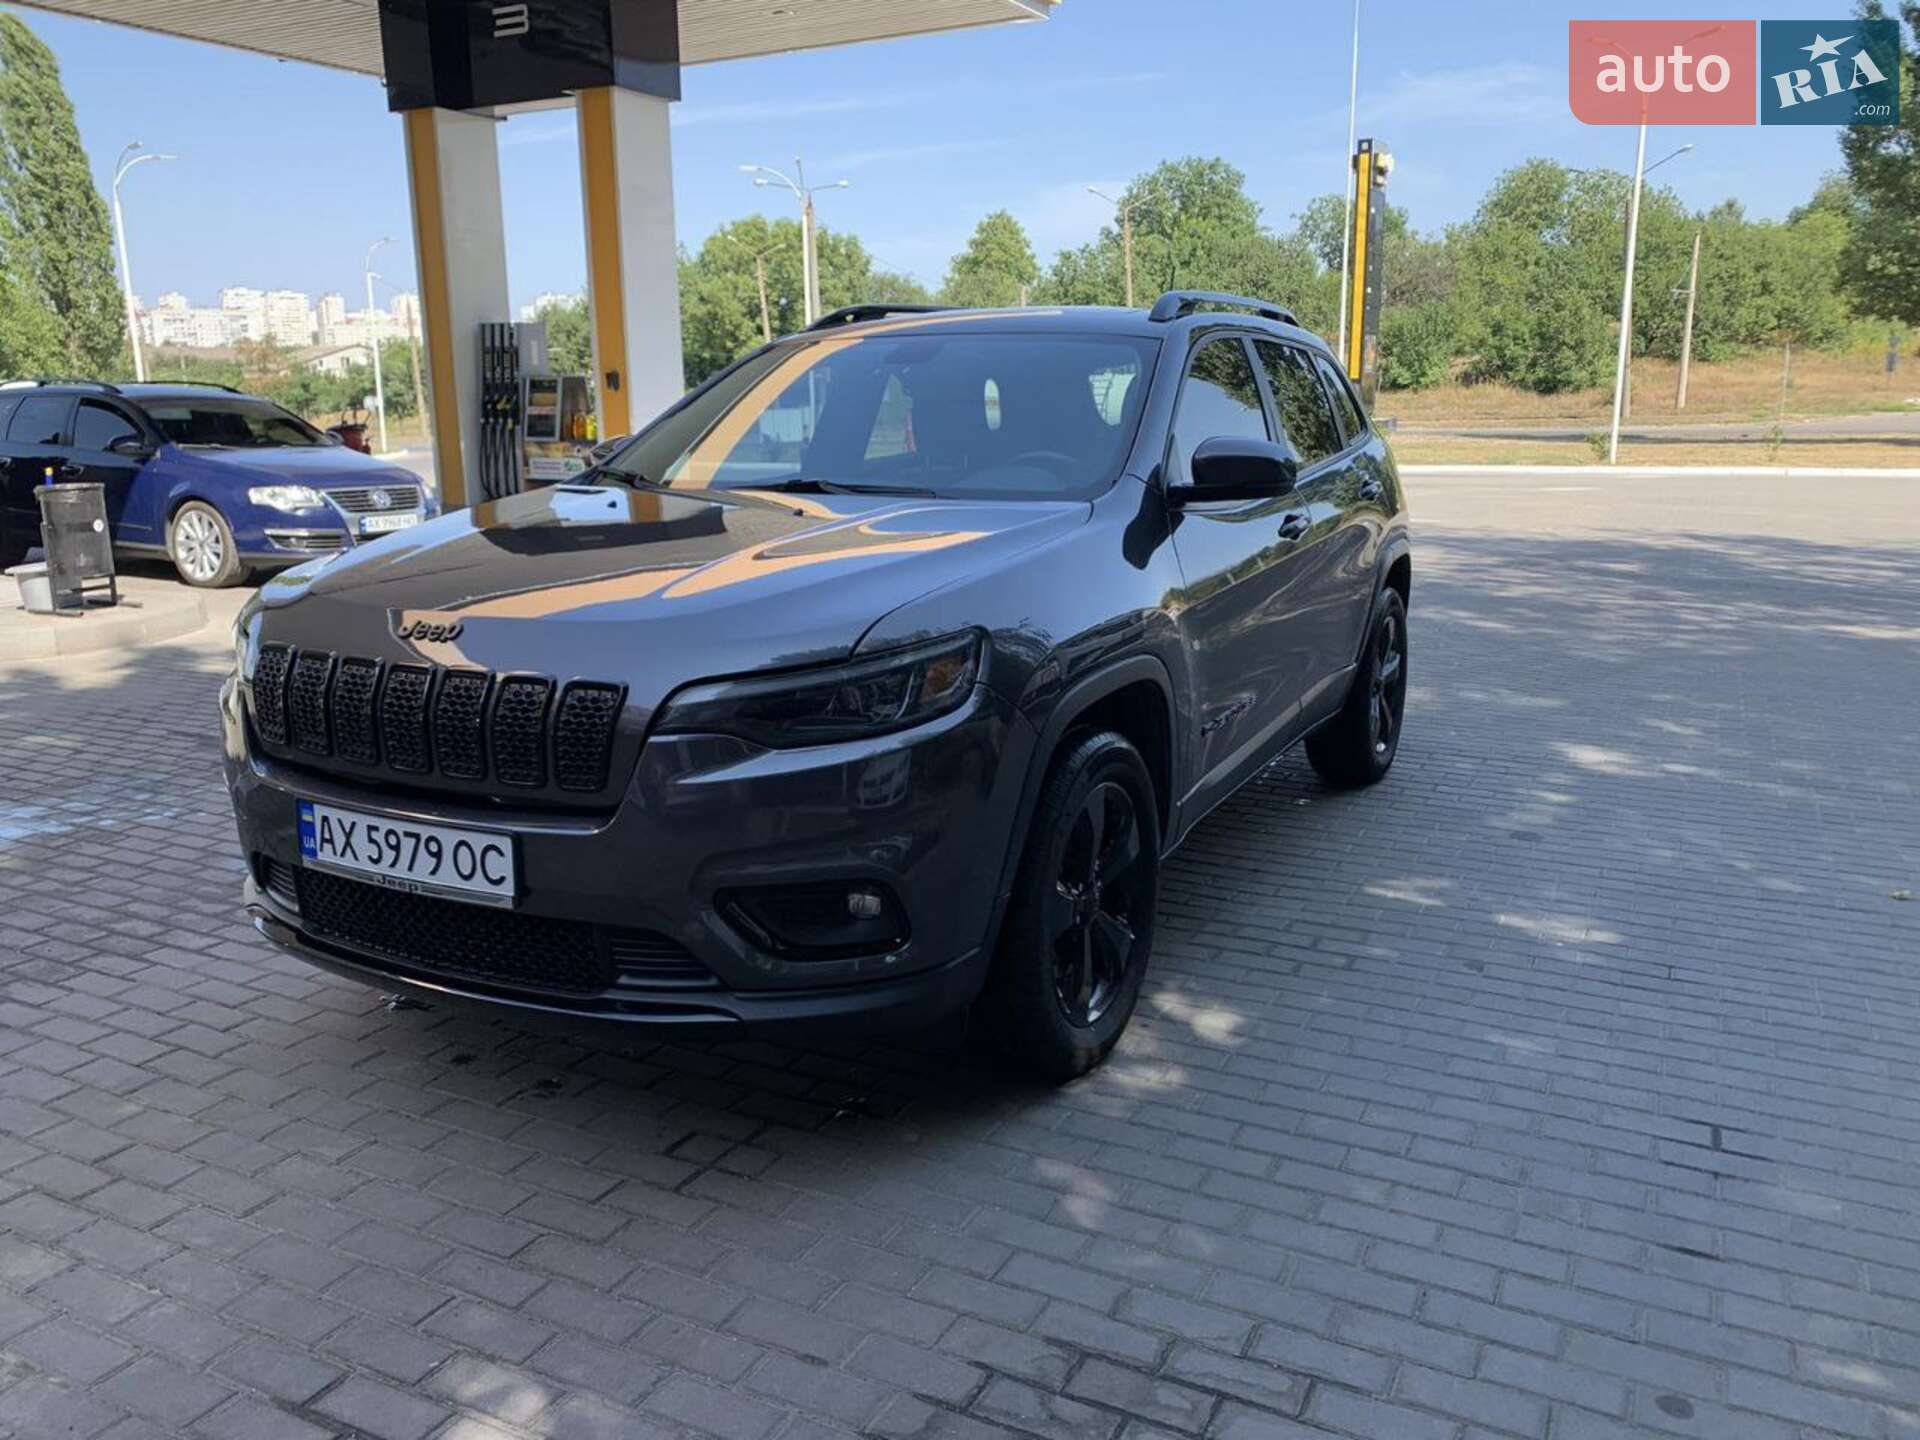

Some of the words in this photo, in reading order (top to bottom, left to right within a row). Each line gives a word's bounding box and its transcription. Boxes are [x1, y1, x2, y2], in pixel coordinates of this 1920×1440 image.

[398, 620, 464, 643] Jeep
[303, 835, 316, 849] UA
[320, 815, 359, 861] AX
[366, 824, 443, 875] 5979
[452, 839, 506, 886] OC
[377, 875, 419, 893] Jeep
